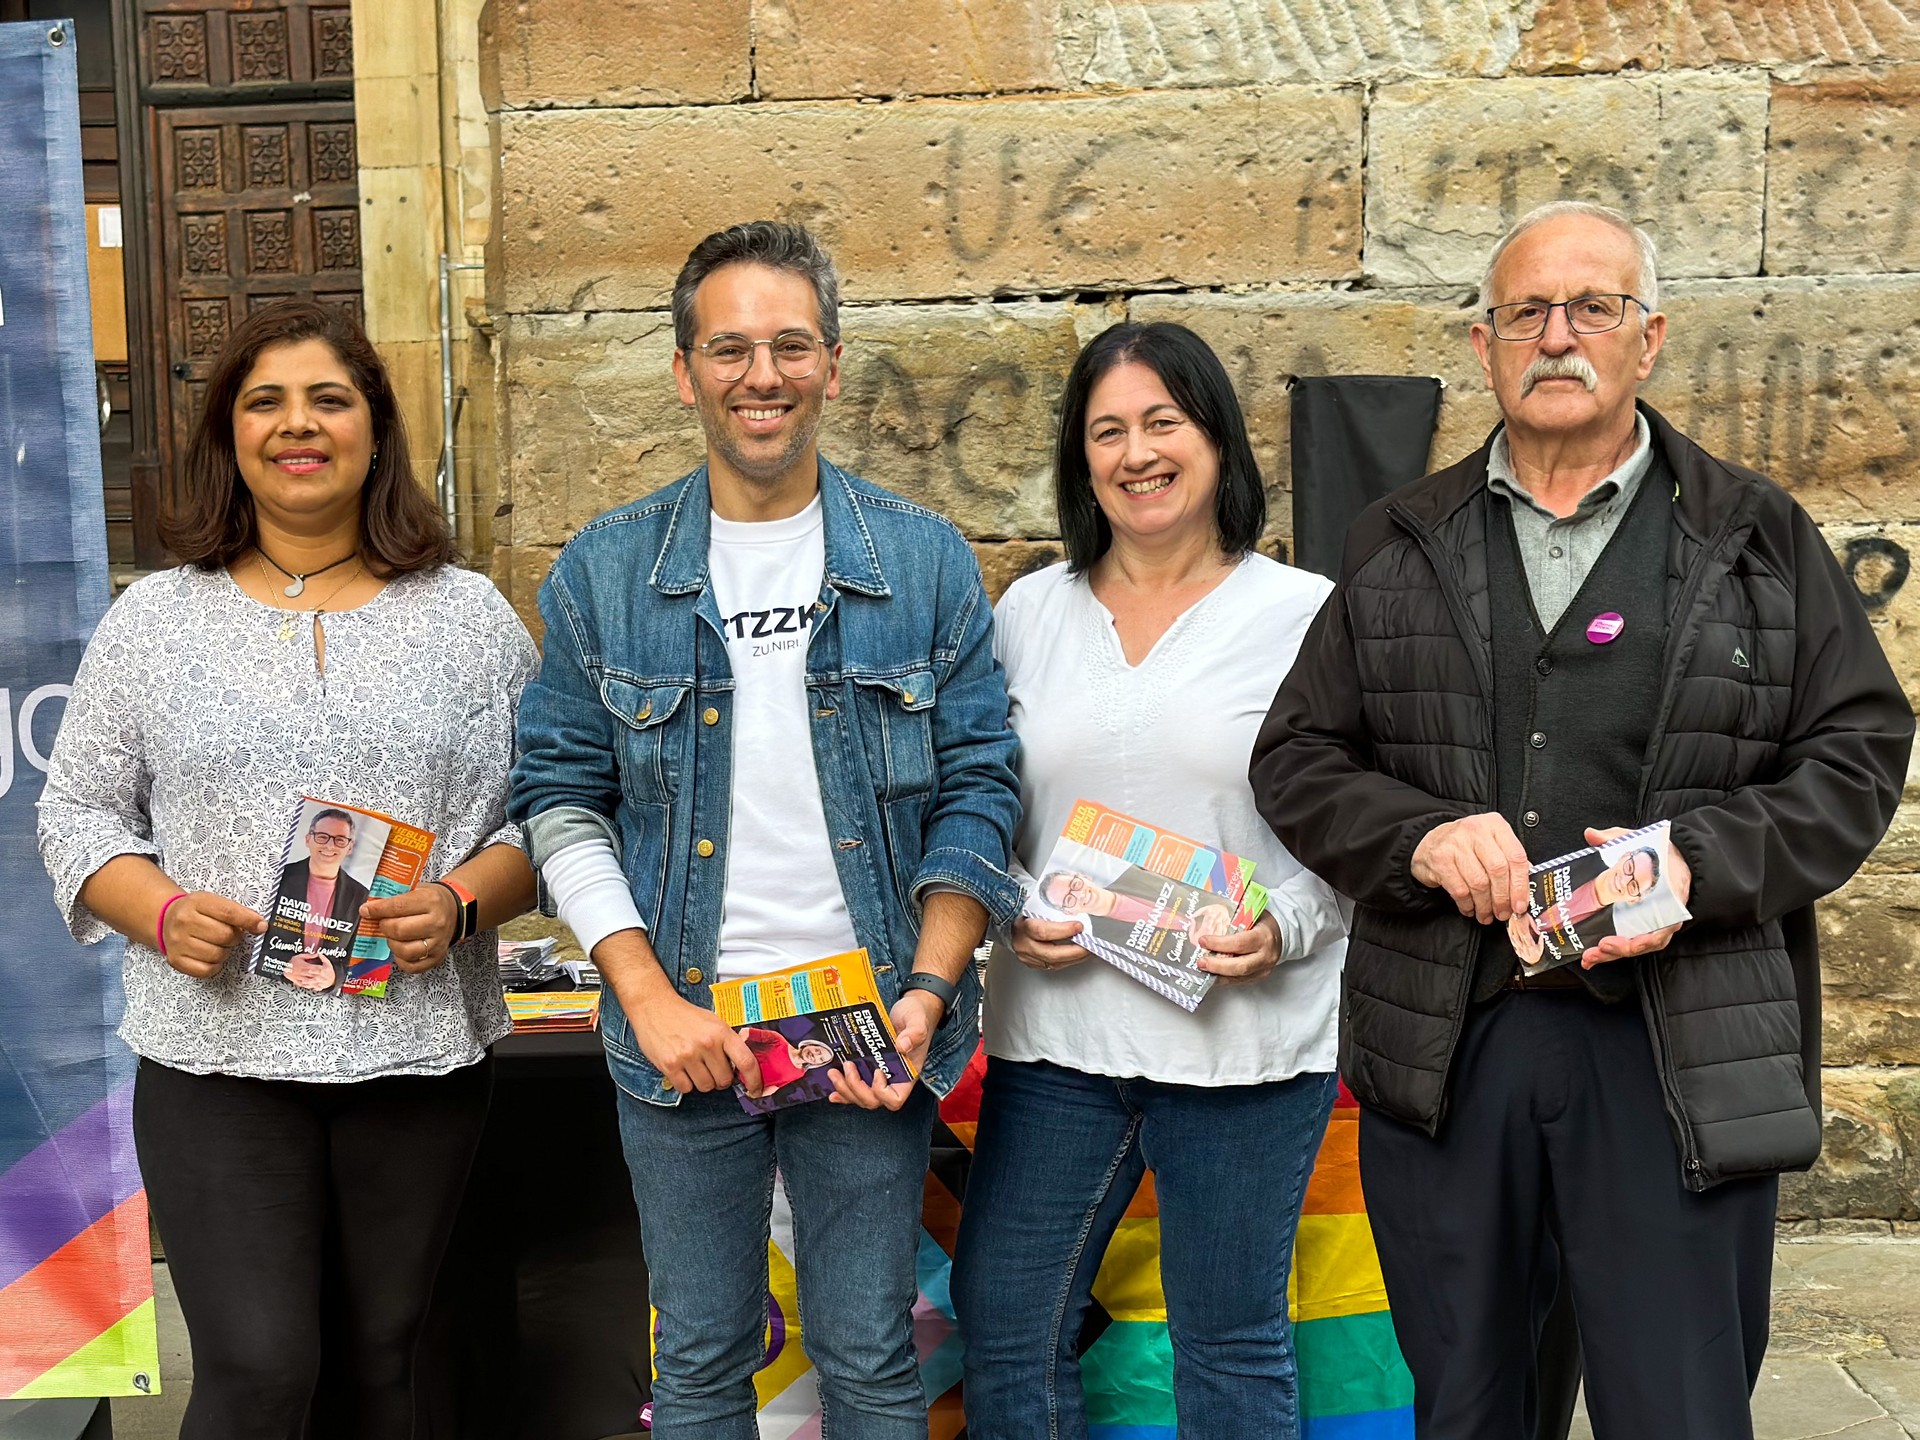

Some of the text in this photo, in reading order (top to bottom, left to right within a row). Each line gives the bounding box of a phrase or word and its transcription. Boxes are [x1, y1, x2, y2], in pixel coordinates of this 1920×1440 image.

[1562, 865, 1572, 901] DAVID
[276, 905, 354, 933] HERNÁNDEZ
[279, 895, 312, 912] DAVID
[1134, 882, 1175, 952] HERNÁNDEZ
[1184, 890, 1200, 919] cambio
[1553, 868, 1585, 952] HERNÁNDEZ
[1125, 918, 1146, 948] DAVID
[1179, 919, 1192, 931] al
[1535, 918, 1547, 931] al
[1541, 931, 1562, 960] cambio
[269, 936, 303, 953] Súmate
[304, 943, 315, 955] al
[317, 946, 347, 957] cambio
[1166, 931, 1188, 963] Súmate
[853, 1011, 892, 1079] DE MADARIAGA
[861, 1009, 887, 1049] ENERITZ
